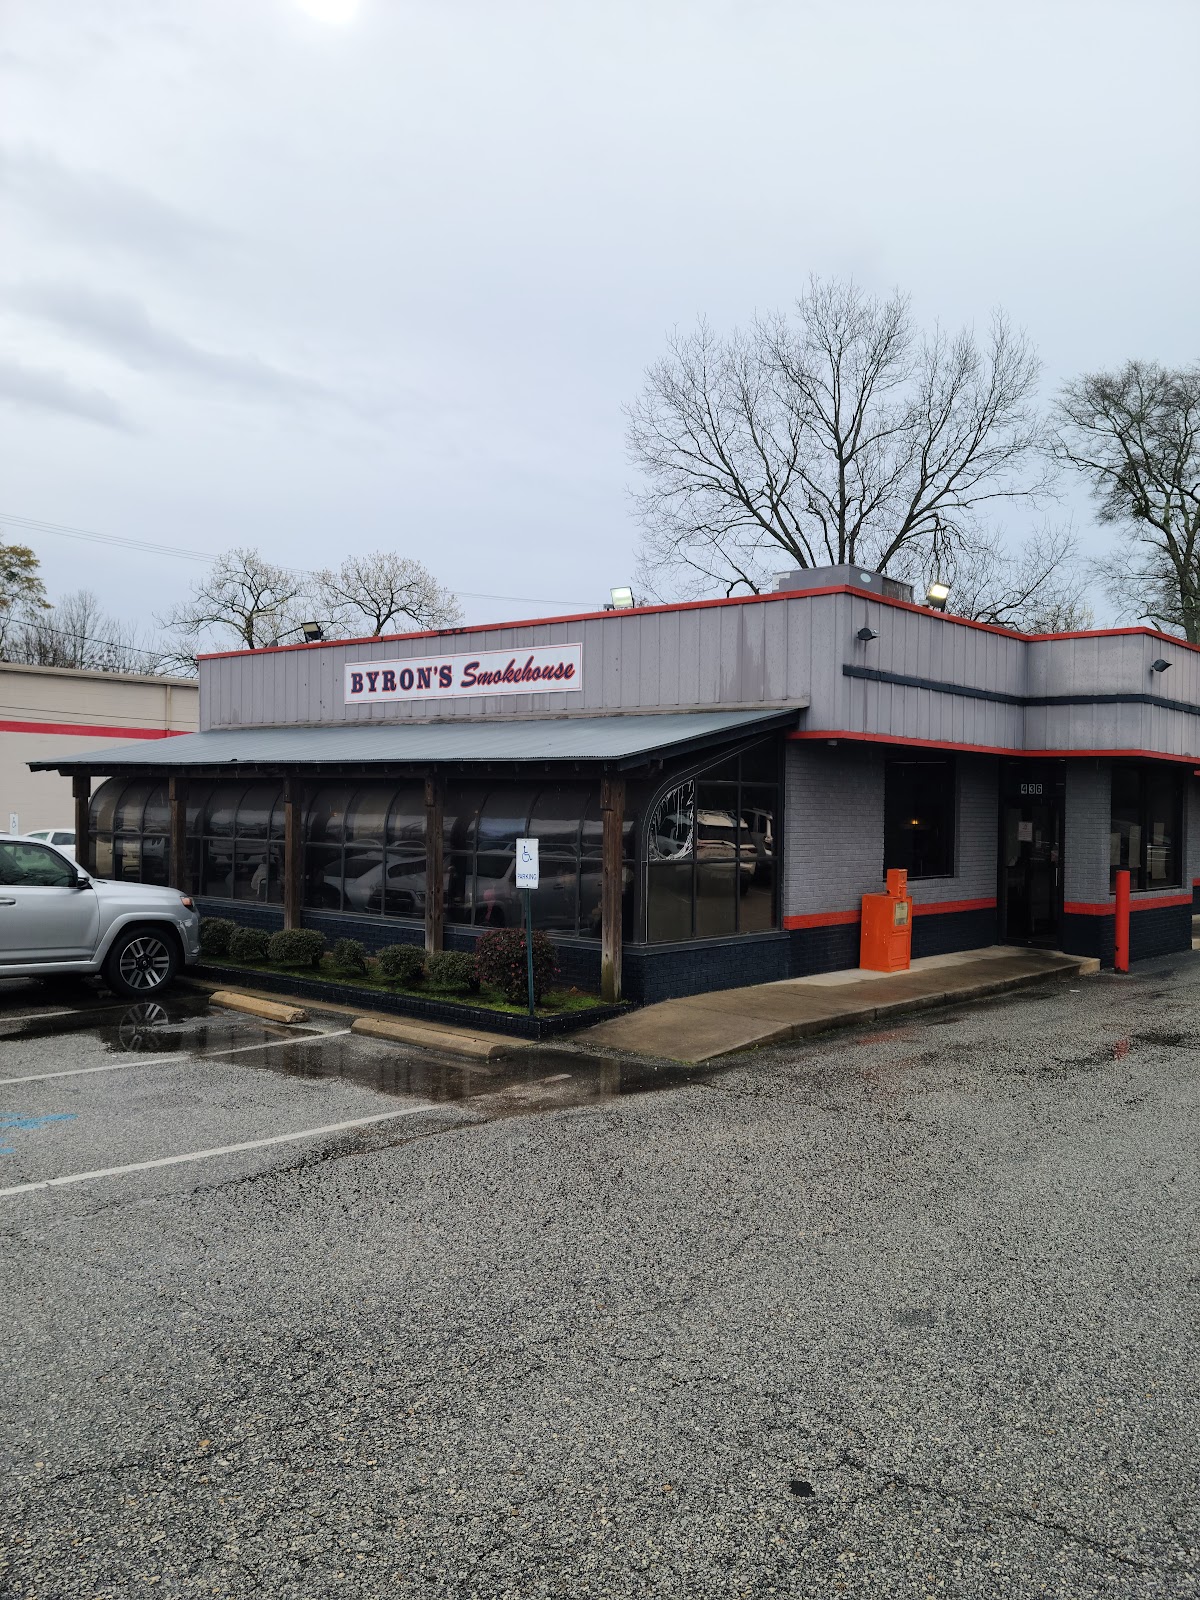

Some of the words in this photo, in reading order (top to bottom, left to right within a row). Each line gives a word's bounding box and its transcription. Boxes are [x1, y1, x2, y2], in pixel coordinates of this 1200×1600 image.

[350, 664, 453, 694] BYRON'S
[460, 655, 576, 688] Smokehouse
[1021, 784, 1042, 794] 436
